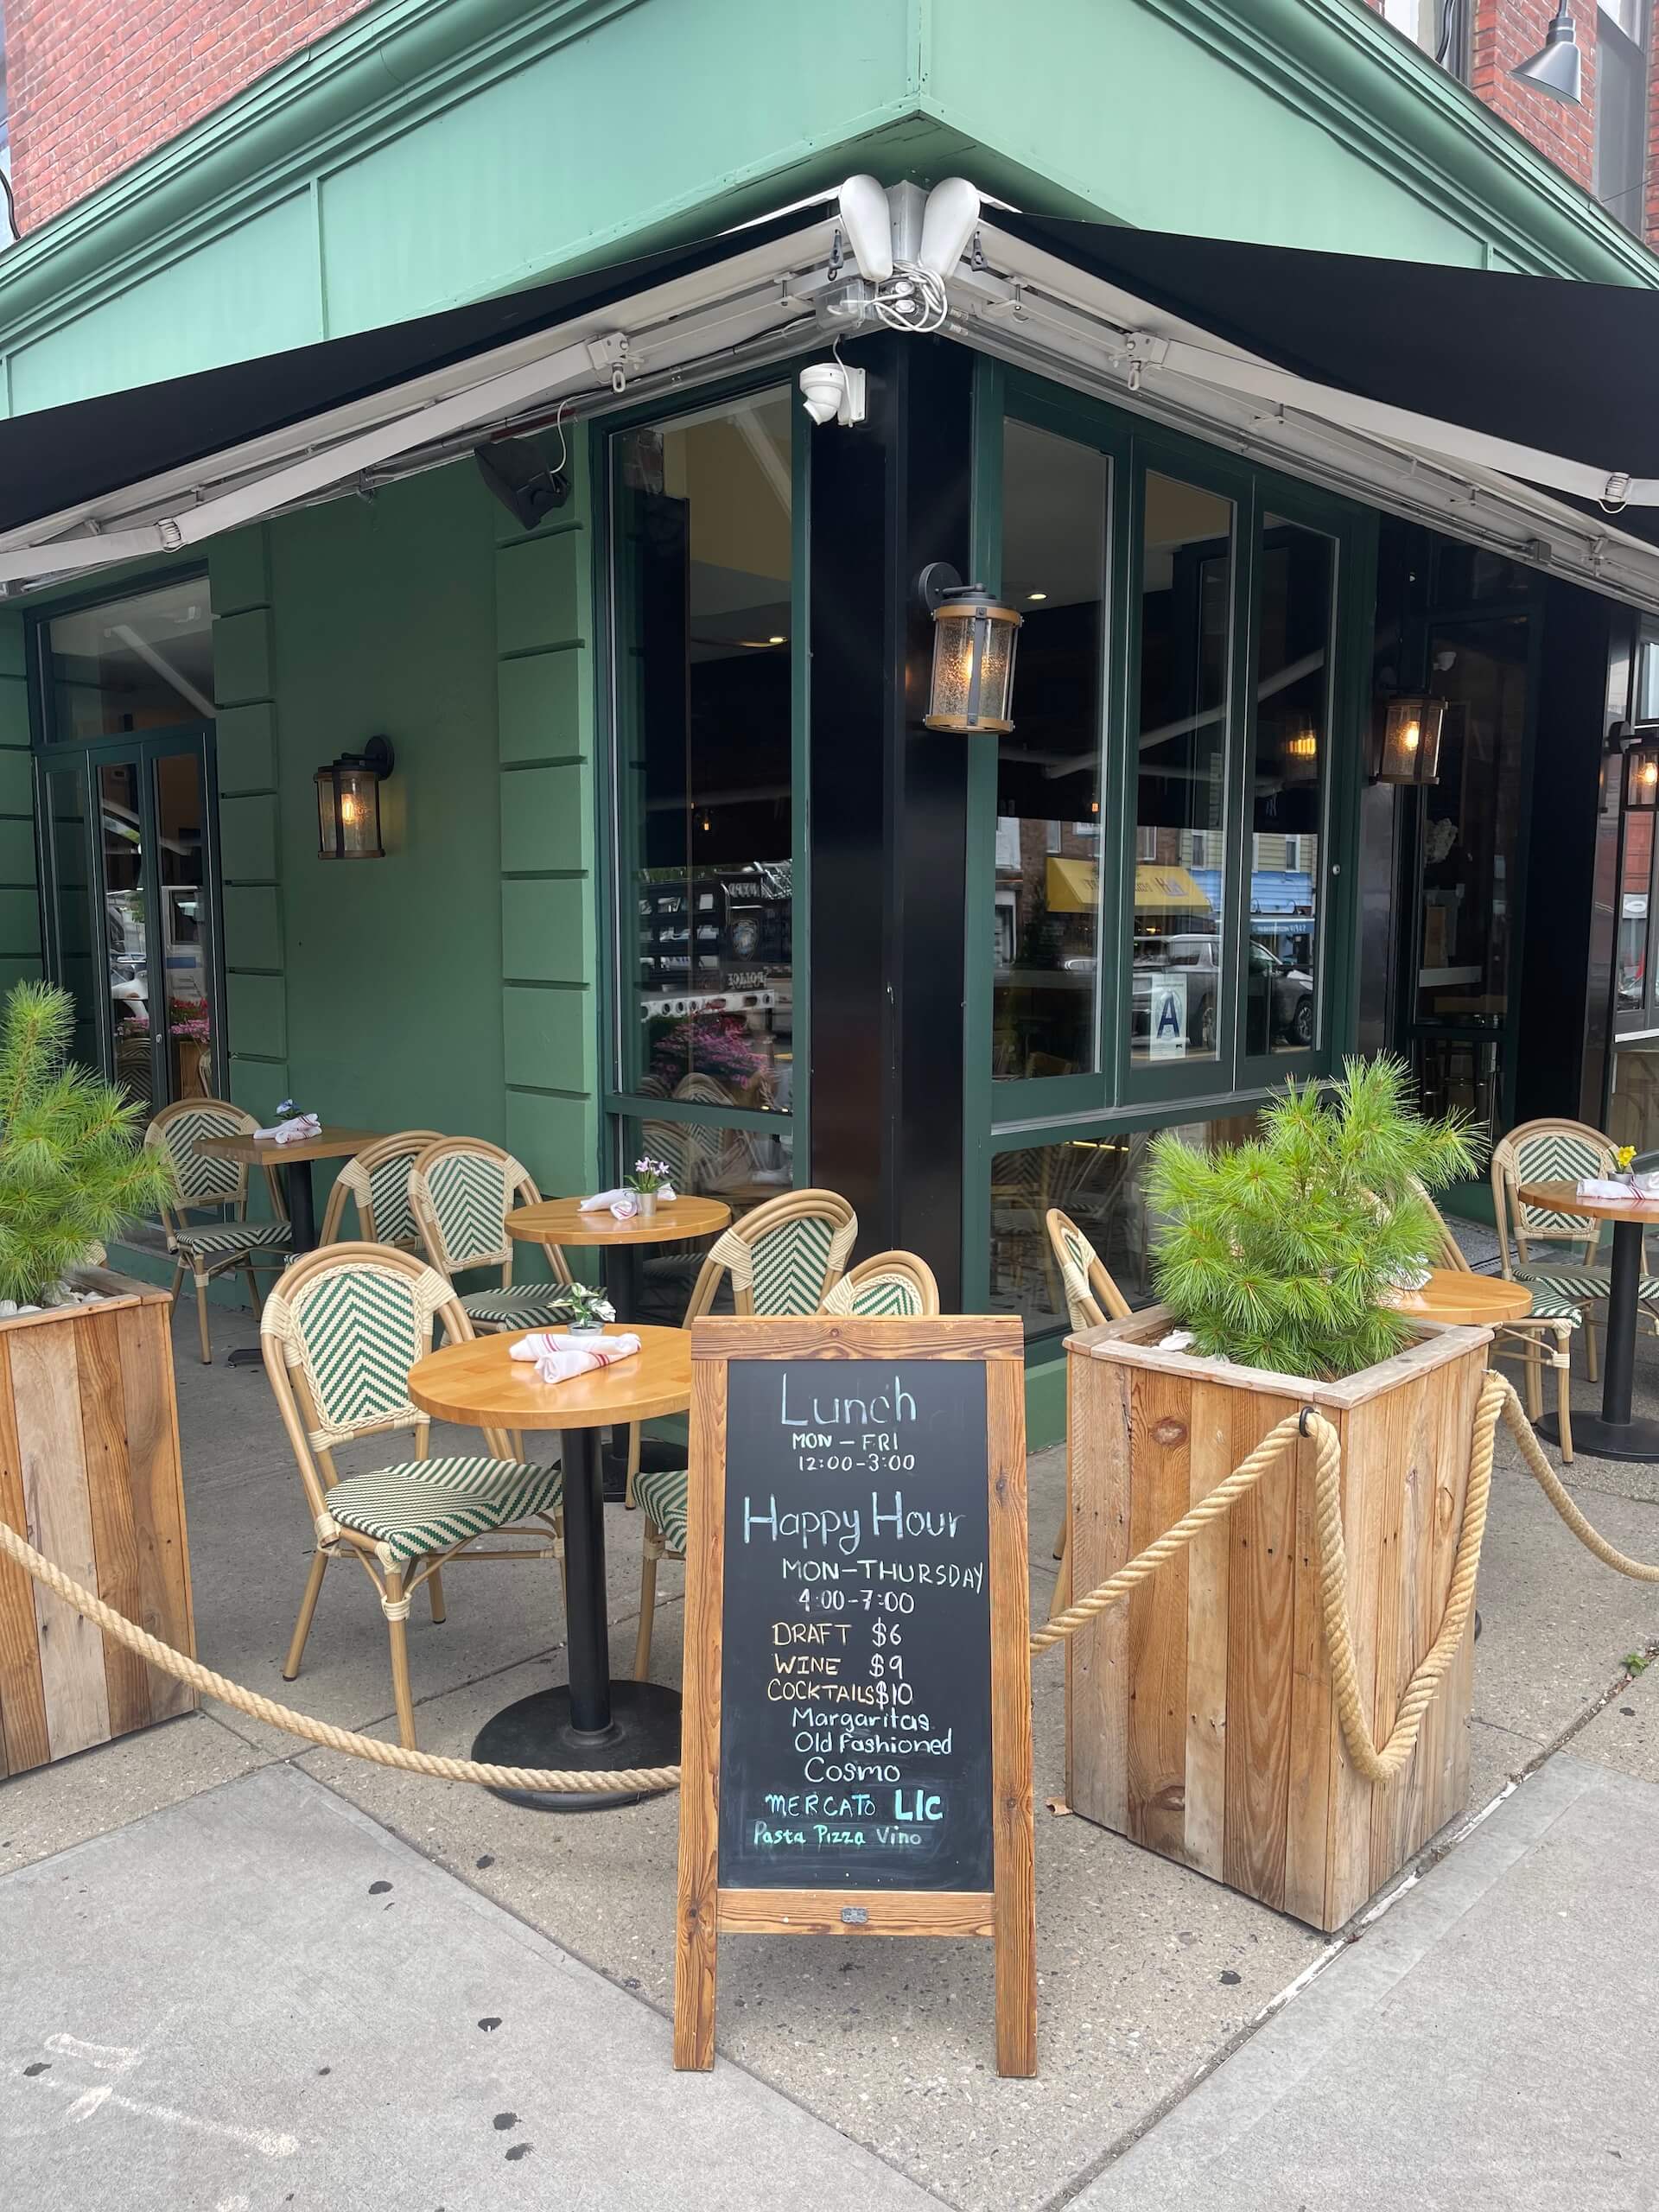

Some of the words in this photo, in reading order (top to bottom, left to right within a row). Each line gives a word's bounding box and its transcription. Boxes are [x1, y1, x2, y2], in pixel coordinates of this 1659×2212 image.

[1157, 992, 1180, 1039] A
[781, 1373, 916, 1425] Lunch
[792, 1433, 832, 1449] MON
[862, 1434, 898, 1450] FRI
[798, 1454, 915, 1471] 12:00-3:00
[744, 1494, 861, 1554] Happy
[872, 1491, 966, 1540] Hour
[782, 1559, 984, 1593] MON-THURSDAY
[798, 1588, 915, 1613] 4:00-7:00
[772, 1622, 852, 1646] DRAFT
[872, 1618, 902, 1647] $6
[774, 1654, 842, 1675] WINE
[869, 1653, 903, 1680] $9
[767, 1680, 874, 1705] COCKTAILS
[875, 1681, 913, 1709] $10
[792, 1707, 930, 1731] Margaritas
[795, 1732, 833, 1753] Old
[840, 1728, 952, 1755] Fashioned
[804, 1757, 900, 1783] Cosmo
[766, 1794, 876, 1818] MERCATO
[754, 1821, 806, 1845] Pasta
[814, 1824, 865, 1845] Pizza
[876, 1826, 922, 1846] Vino
